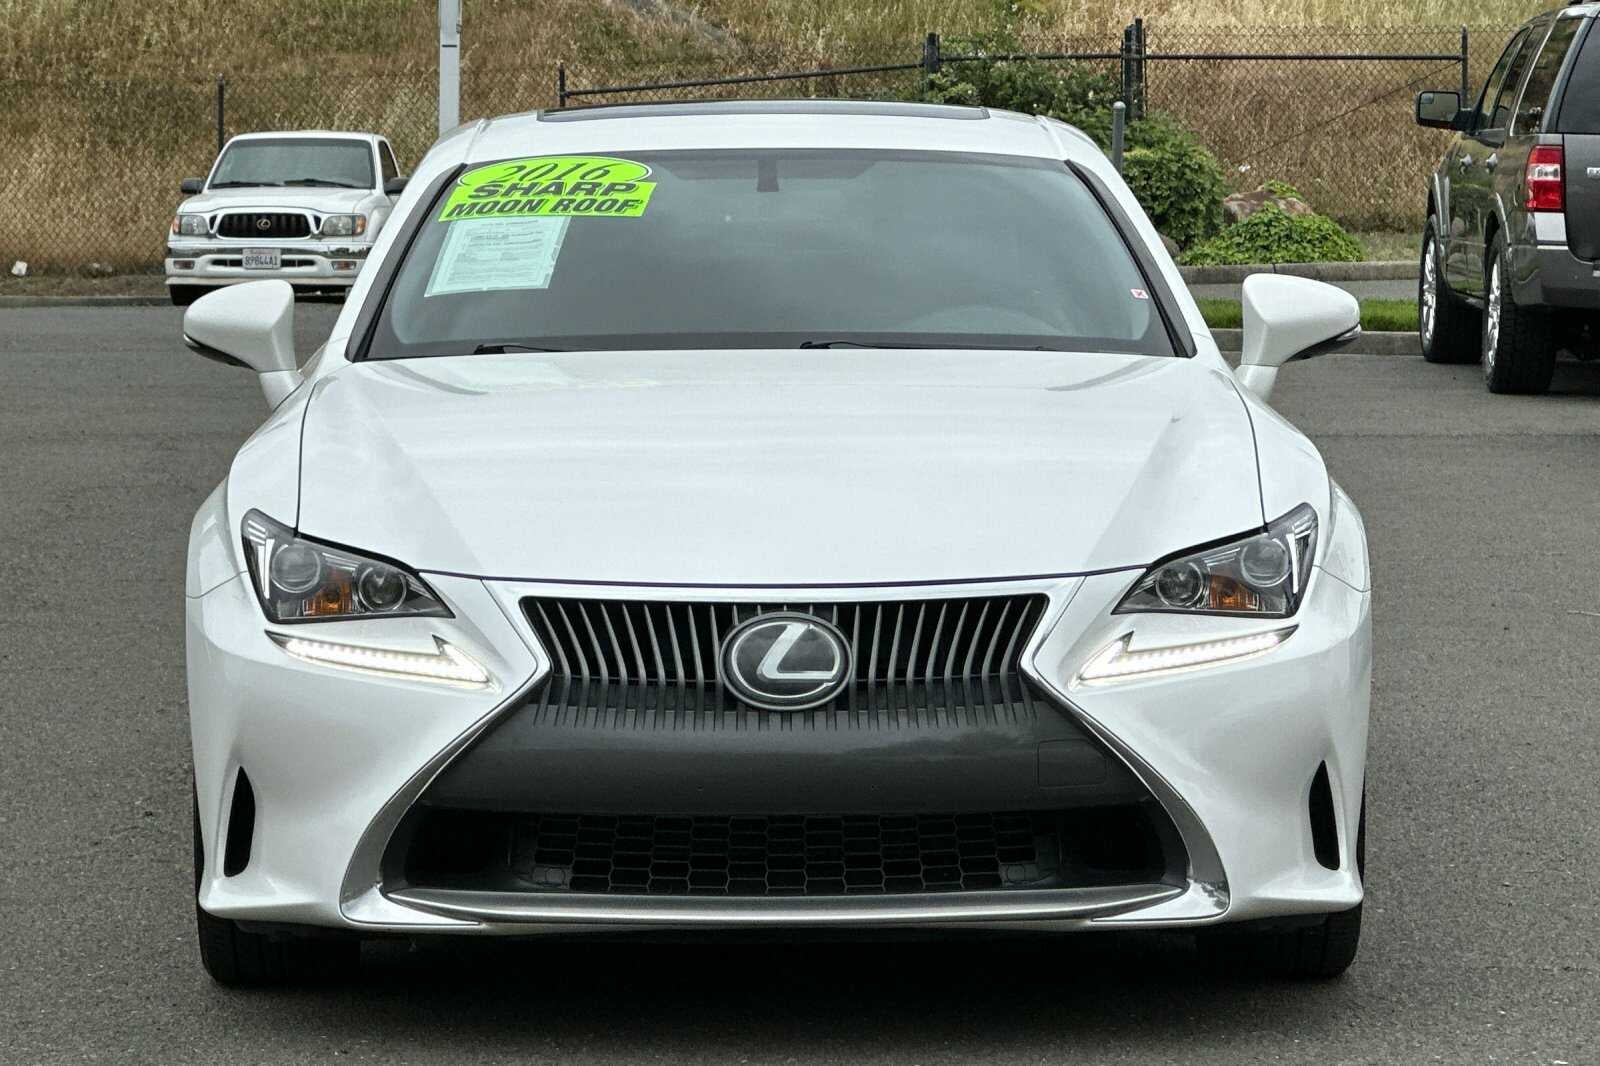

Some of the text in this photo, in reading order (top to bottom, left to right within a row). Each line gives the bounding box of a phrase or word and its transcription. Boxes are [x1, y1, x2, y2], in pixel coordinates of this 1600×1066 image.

[488, 162, 620, 184] 2016
[467, 181, 639, 199] SHARP
[445, 198, 643, 218] MOON ROOF
